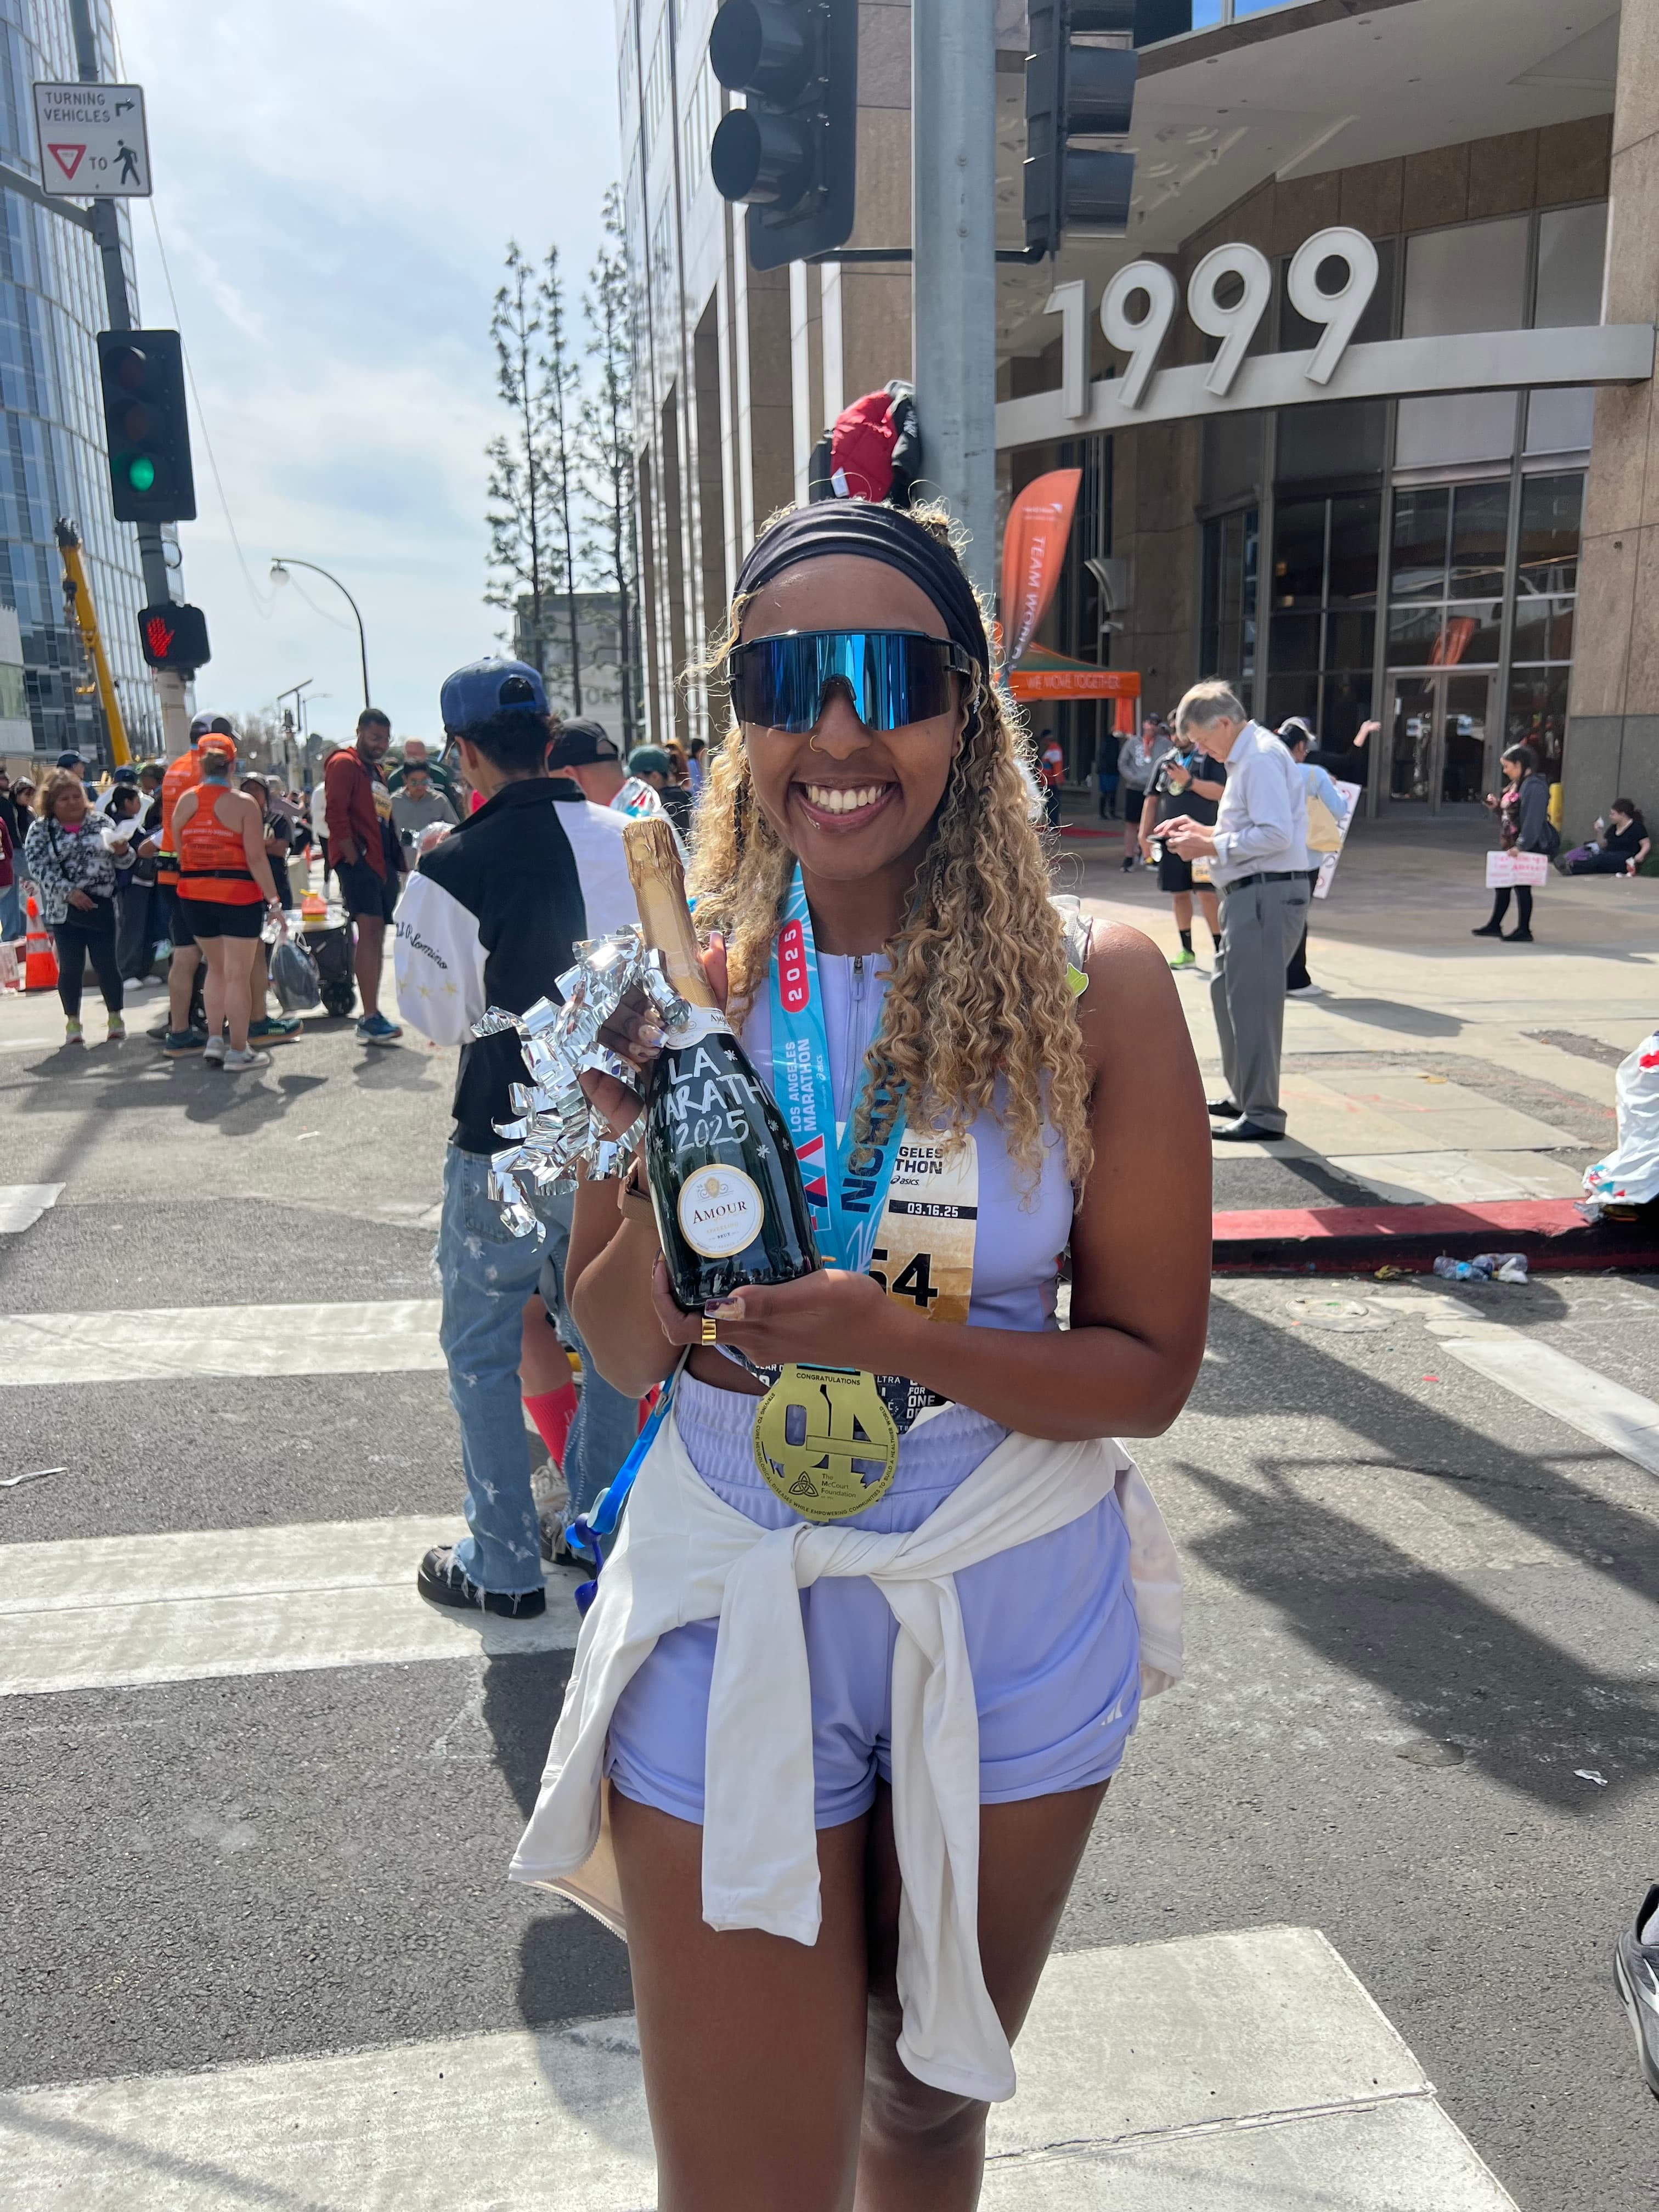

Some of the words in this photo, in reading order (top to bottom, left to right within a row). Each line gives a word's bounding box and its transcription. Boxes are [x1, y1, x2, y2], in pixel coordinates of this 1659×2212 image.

[46, 92, 105, 106] TURNING
[44, 108, 110, 123] VEHICLES
[89, 156, 108, 171] TO
[1043, 226, 1379, 419] 1999
[1028, 535, 1046, 588] TEAM
[1027, 675, 1041, 690] WE
[1043, 674, 1071, 690] MOVE
[1073, 674, 1121, 690] TOGETHER
[785, 929, 802, 1002] 2025
[668, 1047, 721, 1085] LA
[786, 1042, 799, 1101] ANGELES
[798, 1039, 816, 1131] MARATHON
[790, 1107, 802, 1132] LOS
[675, 1109, 749, 1154] 2025
[693, 1200, 748, 1224] AMOUR
[907, 1202, 959, 1218] 03.16.25
[797, 1372, 861, 1385] CONGRATULATIONS
[909, 1387, 926, 1395] FOR
[760, 1392, 776, 1415] STRIVING
[908, 1395, 935, 1407] ONE
[879, 1406, 891, 1424] WORLD
[755, 1441, 772, 1483] NEUROLOGICAL
[885, 1466, 893, 1482] BUILD
[772, 1483, 792, 1503] DISEASES
[821, 1487, 856, 1498] Foundation
[822, 1481, 849, 1489] McCourt
[793, 1502, 809, 1512] WHILE
[849, 1489, 881, 1513] COMMUNITIES
